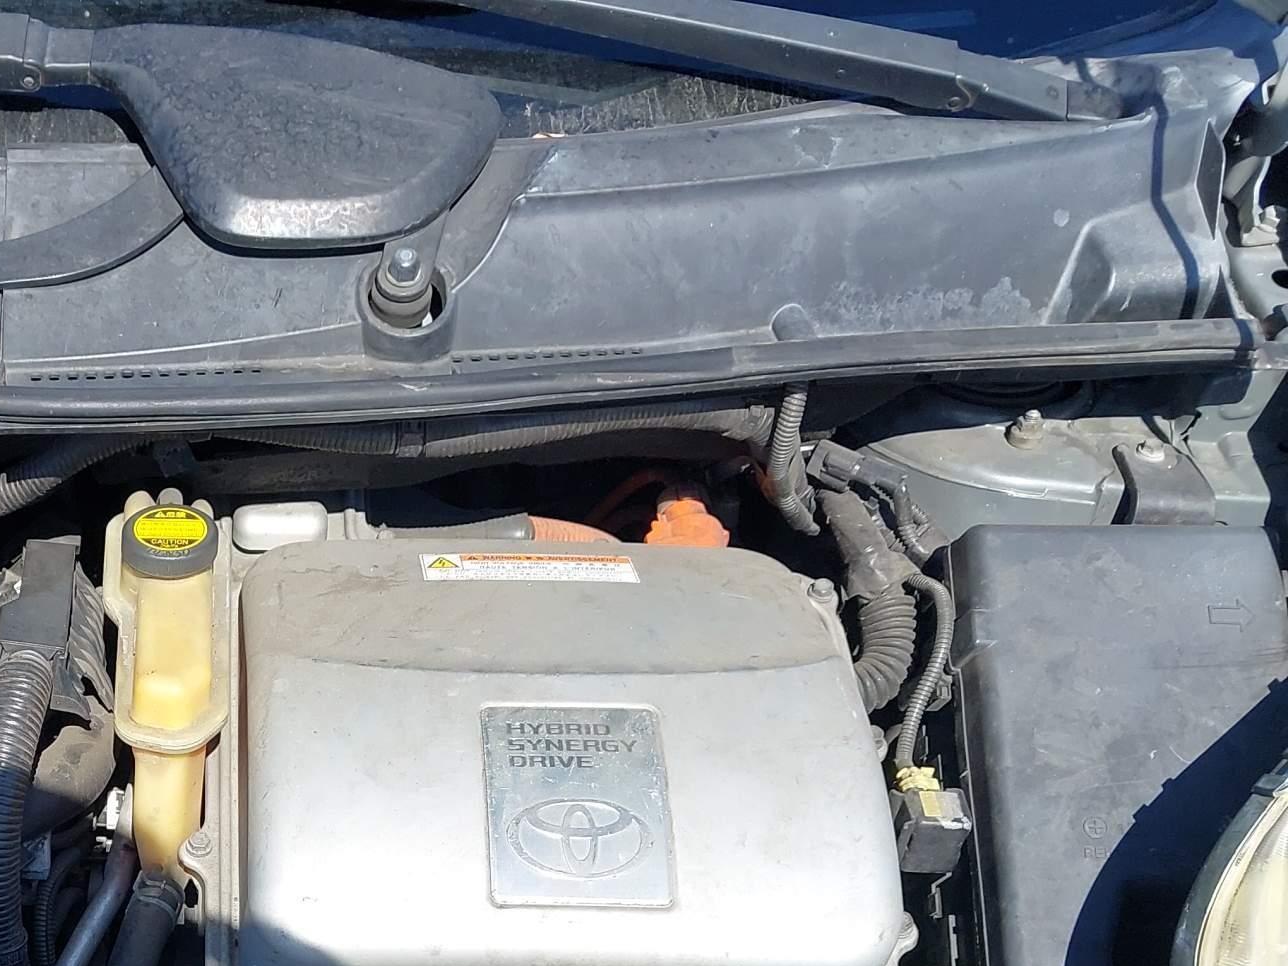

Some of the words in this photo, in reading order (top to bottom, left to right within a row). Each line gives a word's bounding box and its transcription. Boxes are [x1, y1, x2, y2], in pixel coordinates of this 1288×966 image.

[506, 722, 611, 736] HYBRID
[507, 738, 638, 752] SYNERGY
[508, 754, 594, 768] DRIVE
